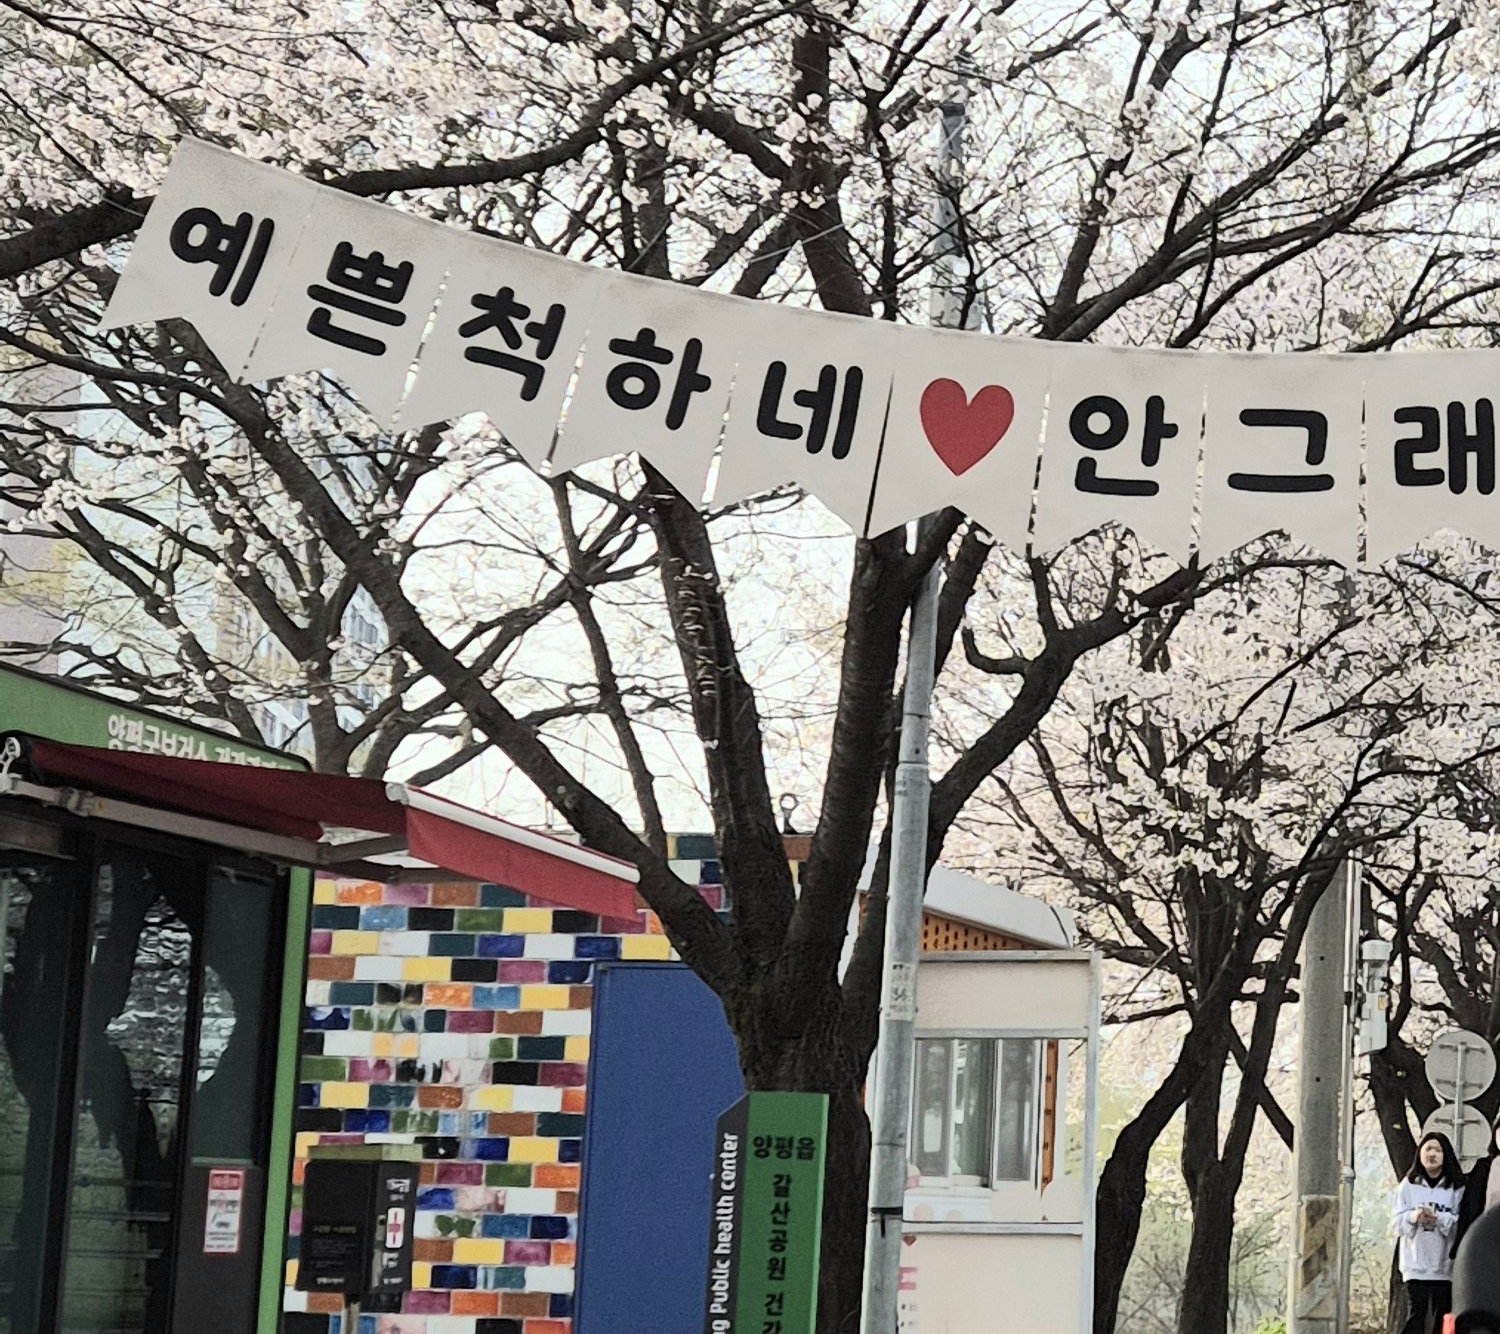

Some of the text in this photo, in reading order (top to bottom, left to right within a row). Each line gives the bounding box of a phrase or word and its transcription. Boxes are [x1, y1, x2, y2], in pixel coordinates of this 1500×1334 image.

[719, 1132, 739, 1192] center
[753, 1134, 816, 1161] 양평읍
[713, 1195, 735, 1255] health
[767, 1173, 792, 1282] 갈산공원
[709, 1258, 731, 1314] Public
